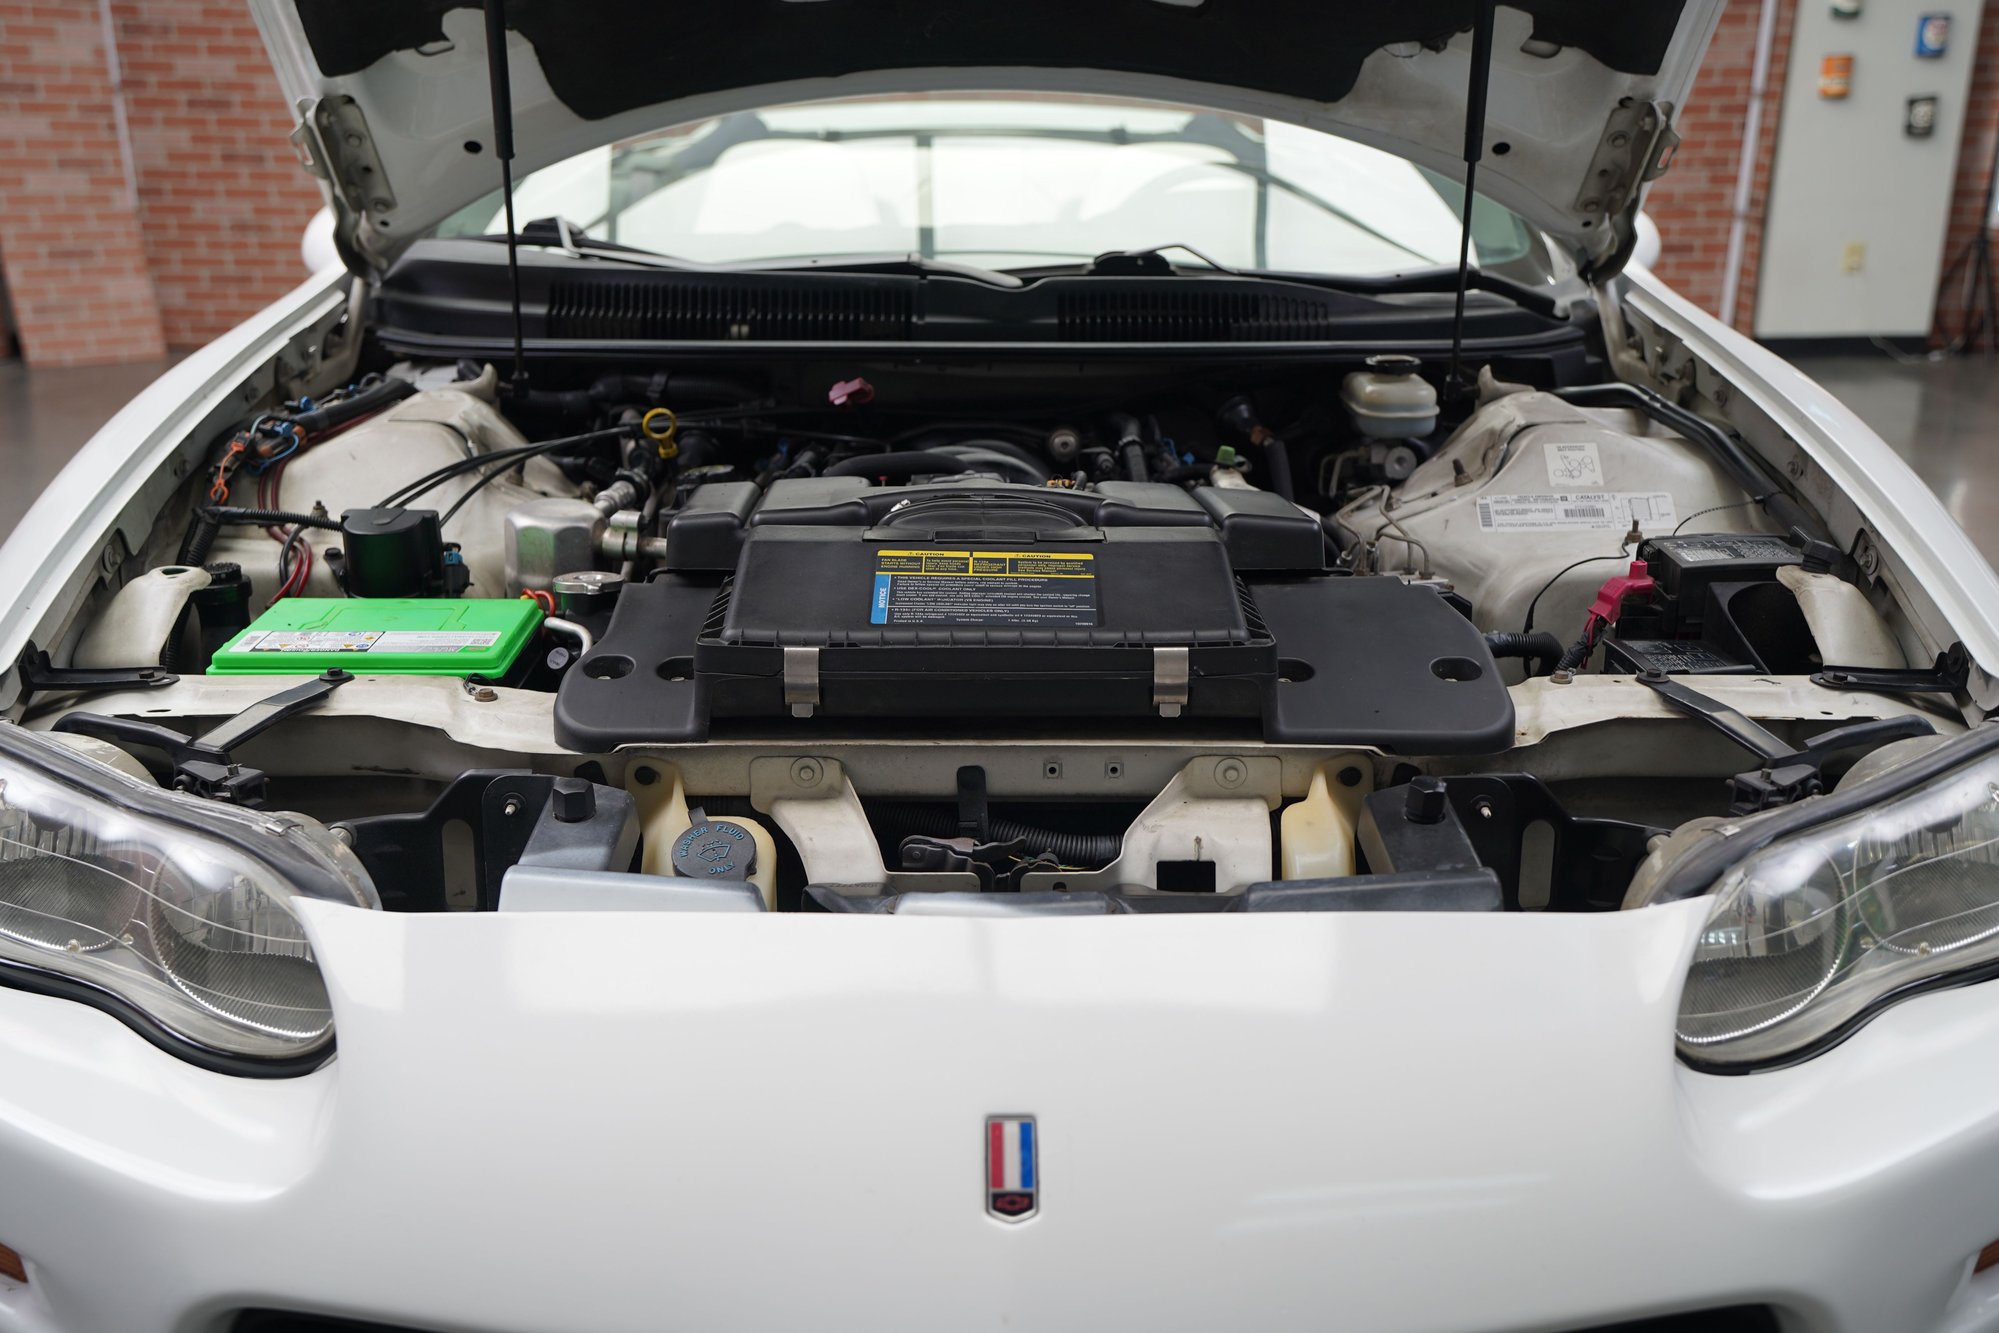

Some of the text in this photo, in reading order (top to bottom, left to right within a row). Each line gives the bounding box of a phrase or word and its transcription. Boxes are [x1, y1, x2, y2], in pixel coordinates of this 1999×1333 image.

[878, 587, 887, 609] NOTICE
[679, 823, 745, 875] WASHER FLUID ONLY
